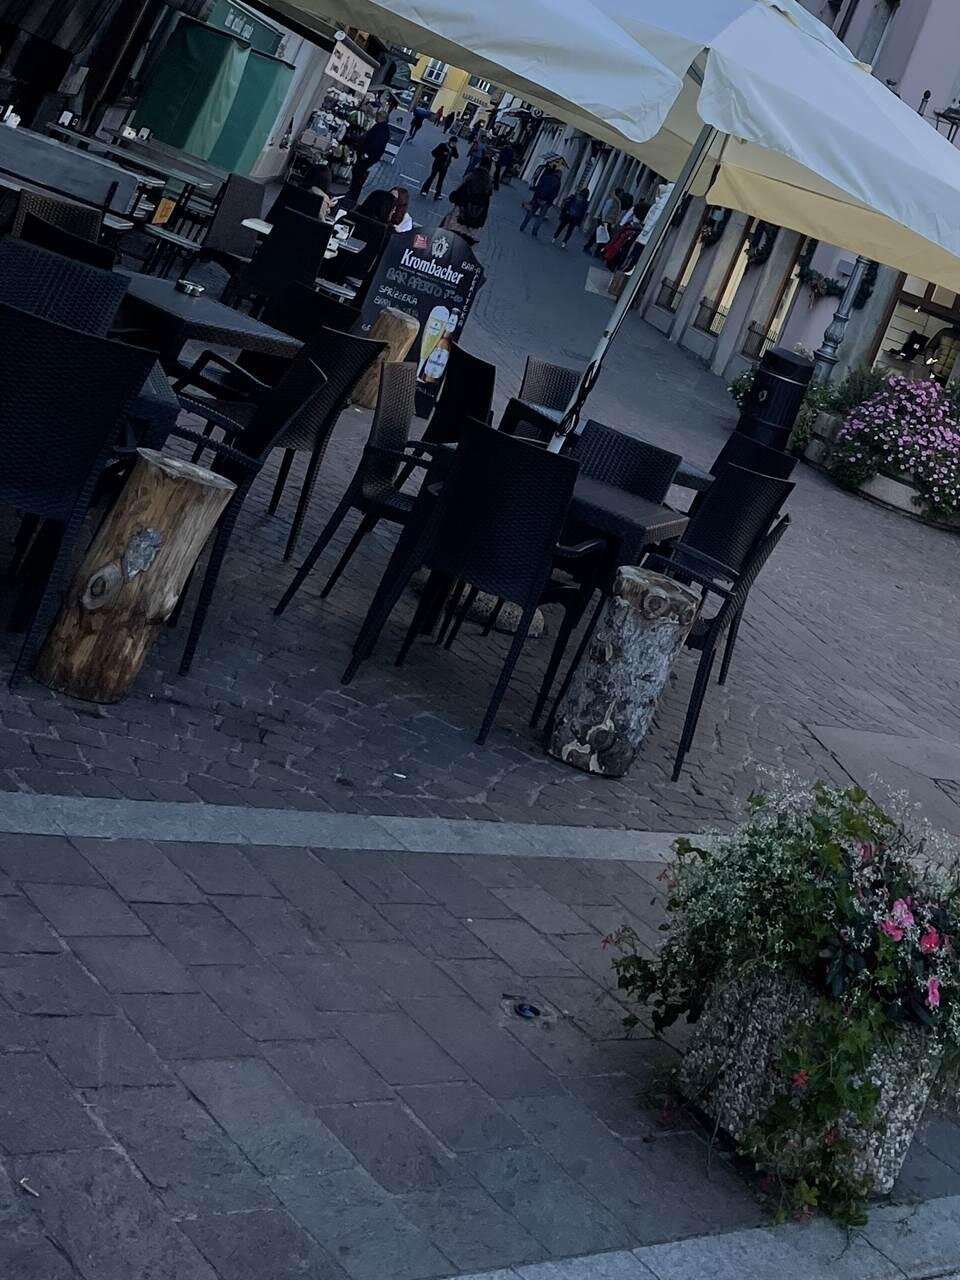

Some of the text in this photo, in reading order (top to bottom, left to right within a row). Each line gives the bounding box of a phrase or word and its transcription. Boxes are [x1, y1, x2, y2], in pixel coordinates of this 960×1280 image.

[386, 267, 408, 285] BAR
[408, 272, 442, 297] APERTO
[400, 248, 464, 285] Krombacher
